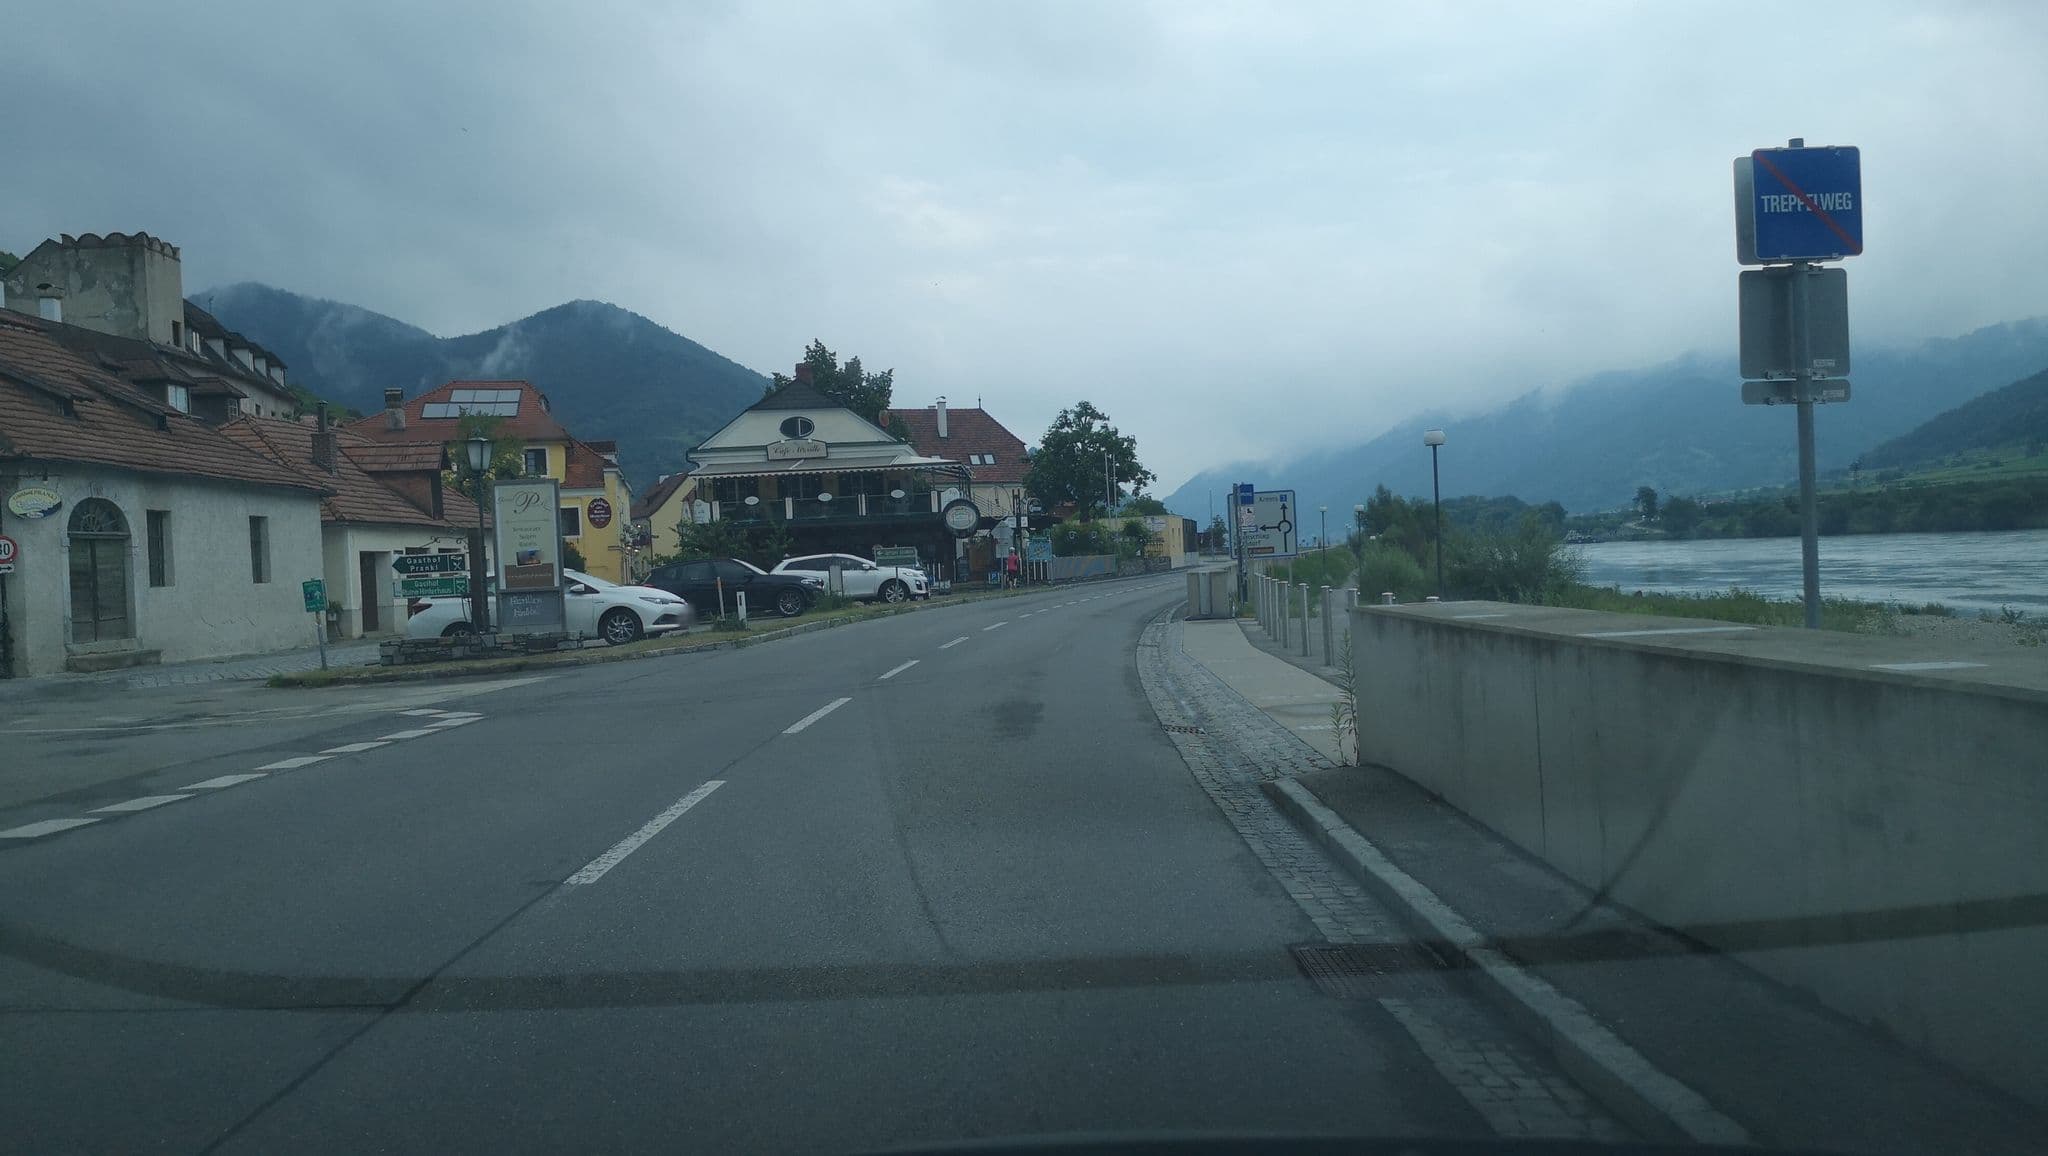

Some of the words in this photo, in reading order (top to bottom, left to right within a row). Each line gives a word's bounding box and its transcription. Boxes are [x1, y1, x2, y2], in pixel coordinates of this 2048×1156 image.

[1761, 192, 1852, 213] TREPPELWEG
[406, 556, 441, 564] Gasthof
[410, 564, 438, 572] Prankl
[414, 579, 439, 587] Gasthof
